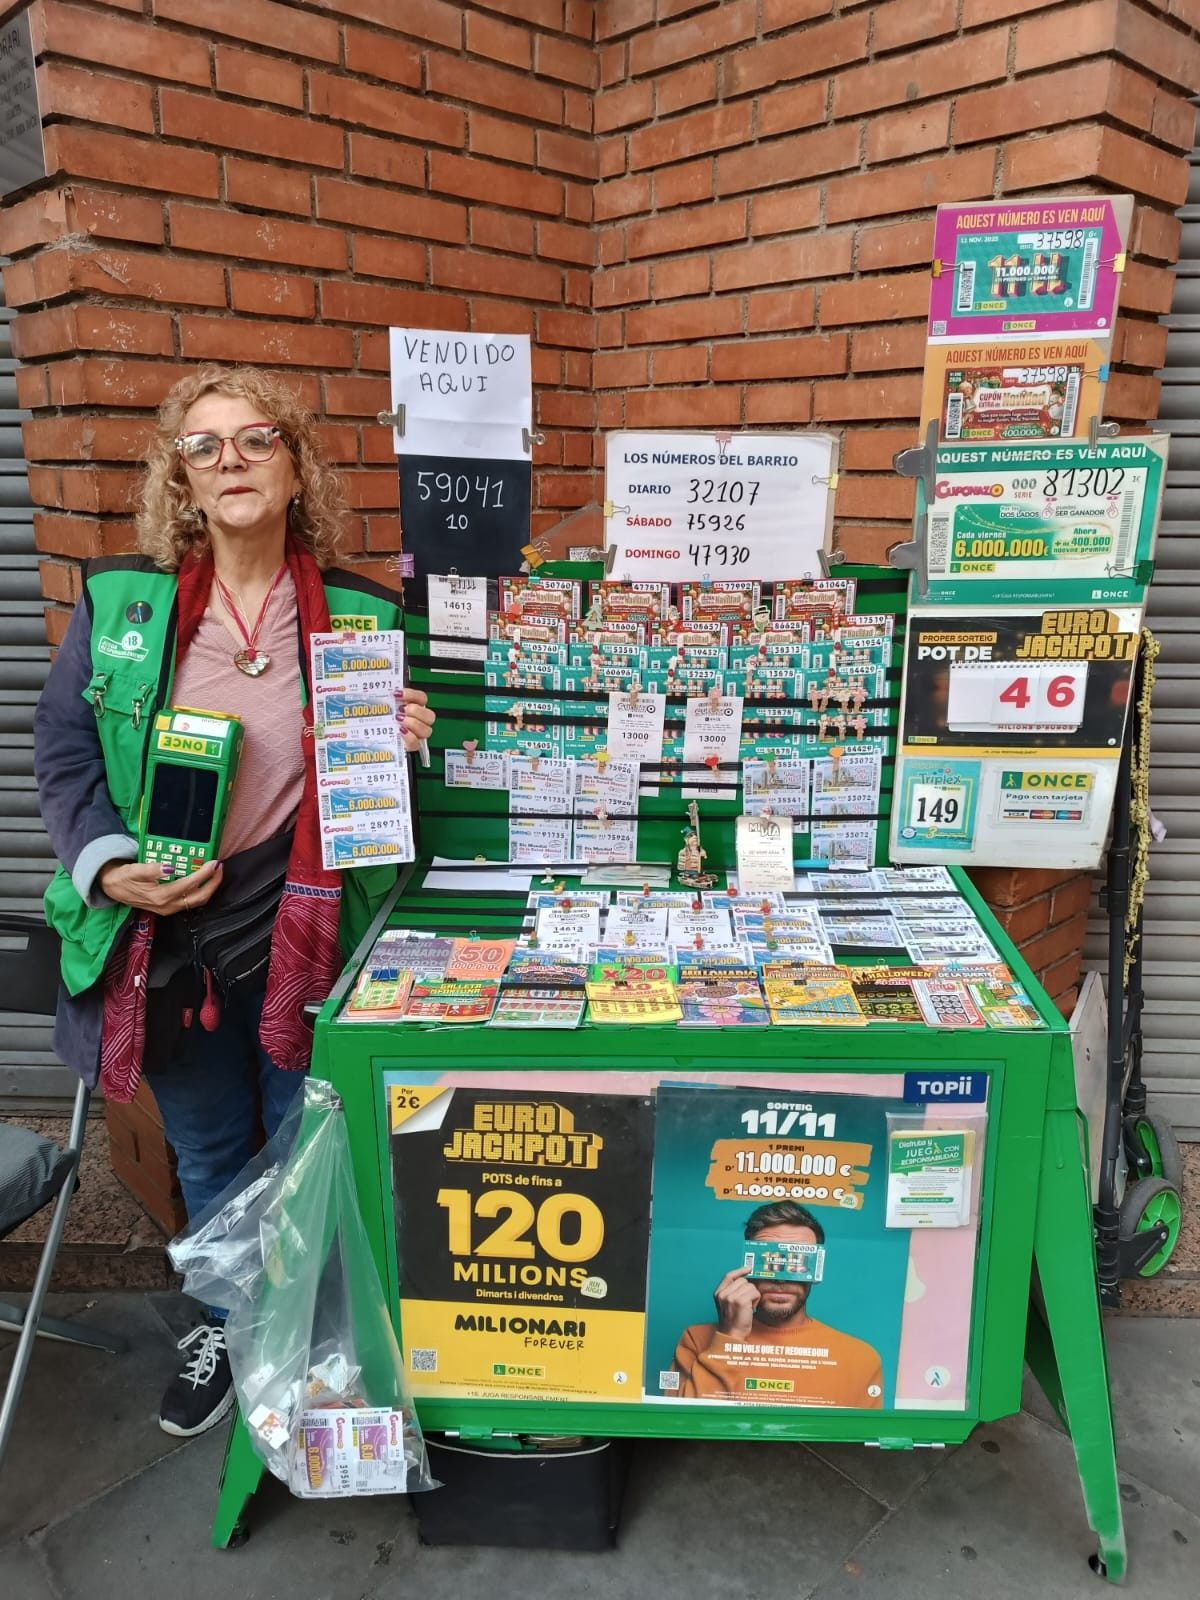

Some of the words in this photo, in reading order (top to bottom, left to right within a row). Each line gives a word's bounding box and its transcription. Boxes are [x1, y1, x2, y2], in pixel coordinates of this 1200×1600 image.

[956, 213, 995, 229] AQUEST
[997, 209, 1040, 227] NÚMERO
[1042, 209, 1056, 224] ES
[1058, 208, 1079, 223] VEN
[1080, 204, 1106, 221] AQUÍ
[1036, 229, 1084, 249] 37598
[982, 302, 1005, 310] ONCE
[1012, 321, 1034, 329] ONCE
[404, 336, 515, 365] VENDIDO
[946, 349, 983, 364] AQUEST
[985, 347, 1025, 362] NÚMERO
[1029, 348, 1040, 359] ES
[1043, 346, 1064, 359] VEN
[1065, 342, 1088, 358] AQUÍ
[1021, 366, 1066, 384] 37598
[420, 373, 488, 394] AQUI
[979, 391, 1002, 401] CUPÓN
[624, 453, 648, 464] LOS
[652, 450, 716, 466] NÚMEROS
[719, 454, 743, 466] DEL
[747, 455, 798, 467] BARRIO
[992, 448, 1050, 463] NÚMERO
[1056, 450, 1074, 460] ES
[1078, 448, 1107, 460] VEN
[1012, 478, 1037, 490] 000
[1043, 467, 1125, 498] 81302
[417, 472, 504, 508] 59041
[628, 484, 671, 495] DIARIO
[687, 479, 760, 506] 32107
[1014, 491, 1033, 499] SERIE
[1070, 509, 1105, 517] GANADOR
[446, 514, 469, 530] 10
[626, 514, 672, 527] SÁBADO
[687, 514, 746, 531] 75926
[957, 531, 975, 539] Cada
[1073, 527, 1097, 535] Ahora
[954, 538, 1049, 558] 6.000.000€
[1070, 536, 1111, 547] 400.000
[625, 549, 680, 560] DOMINGO
[689, 544, 750, 566] 47930
[1080, 546, 1110, 554] premios
[962, 563, 994, 573] ONCE
[444, 601, 472, 610] 14613
[331, 618, 373, 631] ONCE
[1042, 610, 1108, 634] EURO
[361, 634, 392, 643] 28971
[922, 635, 956, 643] PROPER
[957, 635, 994, 643] SORTEIG
[918, 646, 961, 661] POT
[967, 646, 993, 660] DE
[1015, 633, 1131, 660] JACKPOT
[362, 681, 392, 690] 28971
[363, 728, 394, 736] 81302
[622, 732, 649, 740] 13000
[699, 735, 727, 743] 13000
[163, 737, 203, 751] ONCE
[367, 774, 397, 783] 28971
[1027, 774, 1088, 788] ONCE
[1051, 793, 1083, 801] tarjeta
[917, 797, 959, 823] 149
[370, 820, 400, 829] 28971
[682, 970, 758, 979] MILLONARIO
[867, 970, 931, 979] HALLOWEEN
[916, 1076, 973, 1096] TOPii
[767, 1102, 813, 1112] SORTEIG
[473, 1102, 558, 1133] EURO
[741, 1109, 836, 1138] 11/11
[443, 1131, 588, 1167] JACKPOT
[776, 1144, 805, 1152] PREMI
[898, 1140, 927, 1149] Disfruta
[928, 1139, 933, 1147] y
[943, 1145, 960, 1153] CON
[735, 1151, 836, 1176] 11.000.000
[901, 1152, 960, 1166] RESPONSABILIDAD
[482, 1172, 513, 1185] POTS
[515, 1174, 530, 1186] de
[531, 1175, 553, 1187] fins
[555, 1178, 563, 1187] a
[764, 1176, 773, 1184] 11
[775, 1177, 811, 1185] PREMIS
[723, 1187, 732, 1195] D'
[734, 1183, 829, 1199] 1.000.000
[436, 1188, 605, 1263] 120
[452, 1262, 589, 1288] MILIONS
[476, 1288, 513, 1299] Dimarts
[518, 1290, 564, 1302] divendres
[454, 1315, 586, 1338] MILIONARI
[524, 1336, 584, 1350] FOREVER
[725, 1343, 732, 1352] SI
[733, 1343, 742, 1353] NO
[743, 1344, 760, 1354] VOLS
[761, 1345, 775, 1355] QUE
[775, 1346, 784, 1355] ET
[508, 1366, 542, 1377] ONCE
[759, 1381, 791, 1390] ONCE
